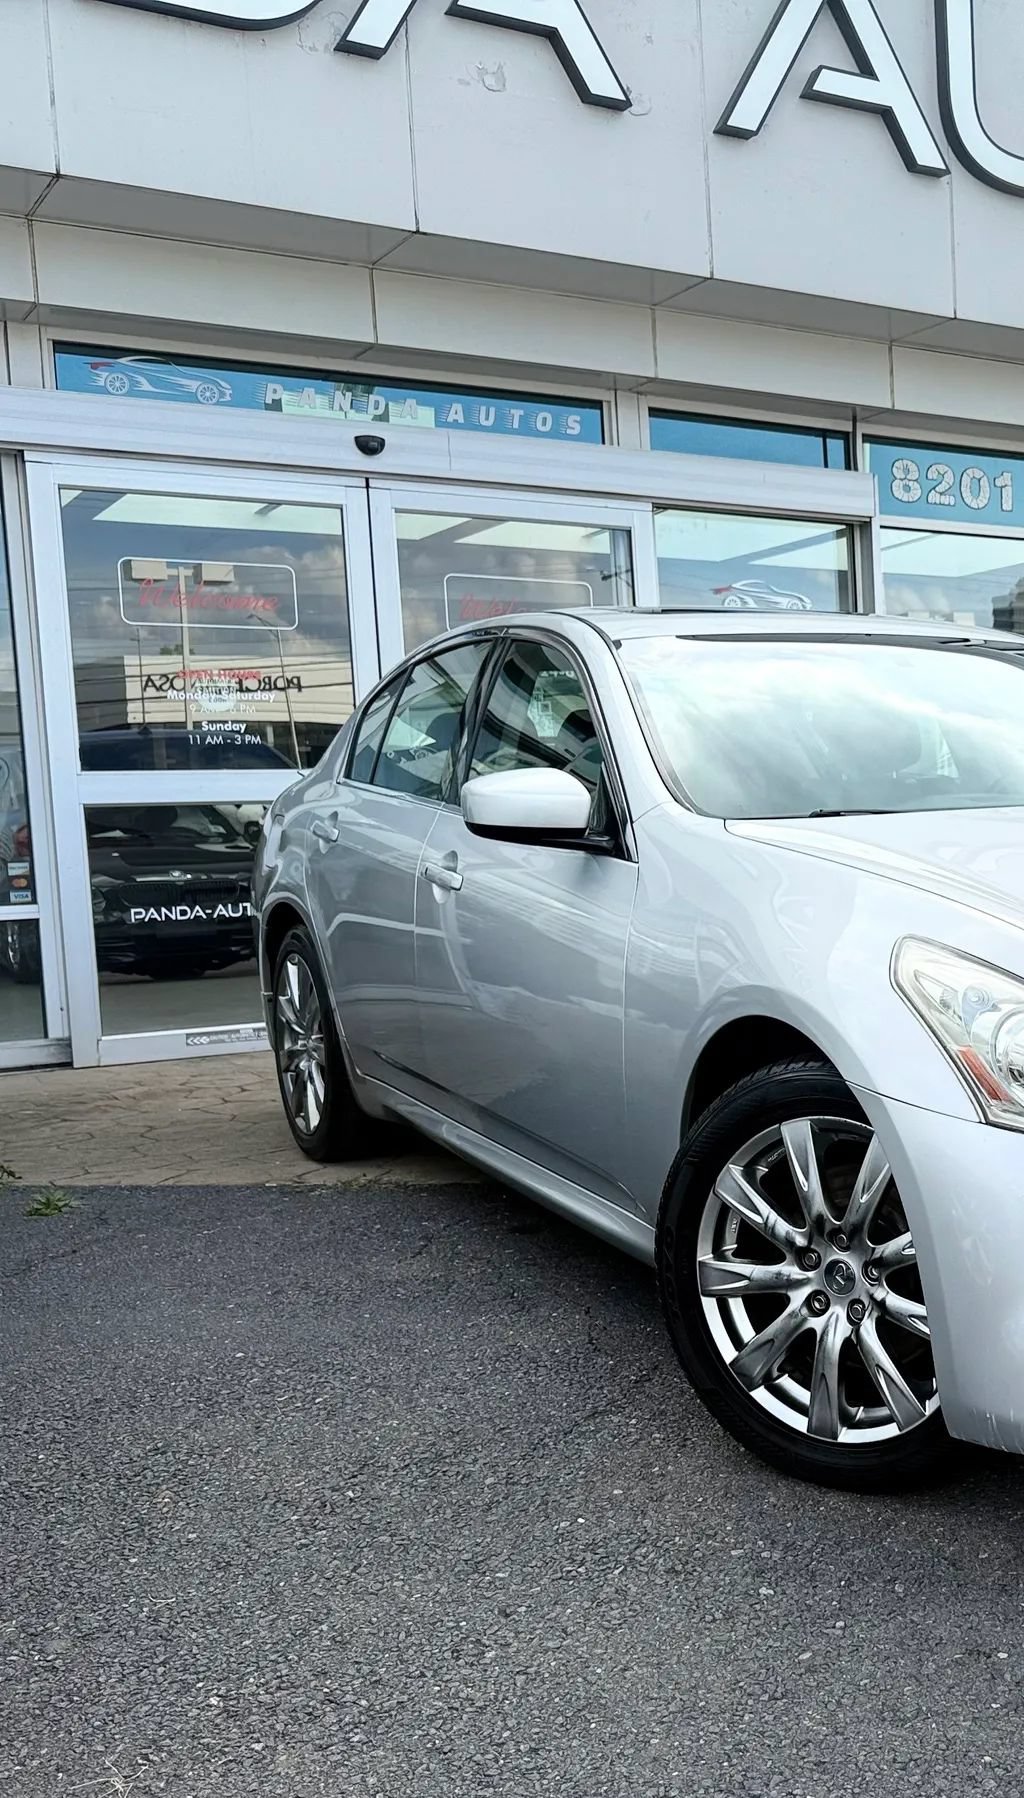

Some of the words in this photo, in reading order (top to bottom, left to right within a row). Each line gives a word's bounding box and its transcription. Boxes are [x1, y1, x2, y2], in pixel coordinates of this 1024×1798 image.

[257, 382, 419, 421] PANDA
[442, 402, 582, 436] AUTOS
[890, 458, 1014, 513] 8201
[138, 577, 280, 612] Welcome
[167, 688, 277, 704] Monday-Saturday
[201, 720, 247, 733] Sunday
[188, 734, 201, 745] 11
[205, 734, 224, 745] AM
[234, 734, 242, 745] 3
[245, 734, 262, 745] PM
